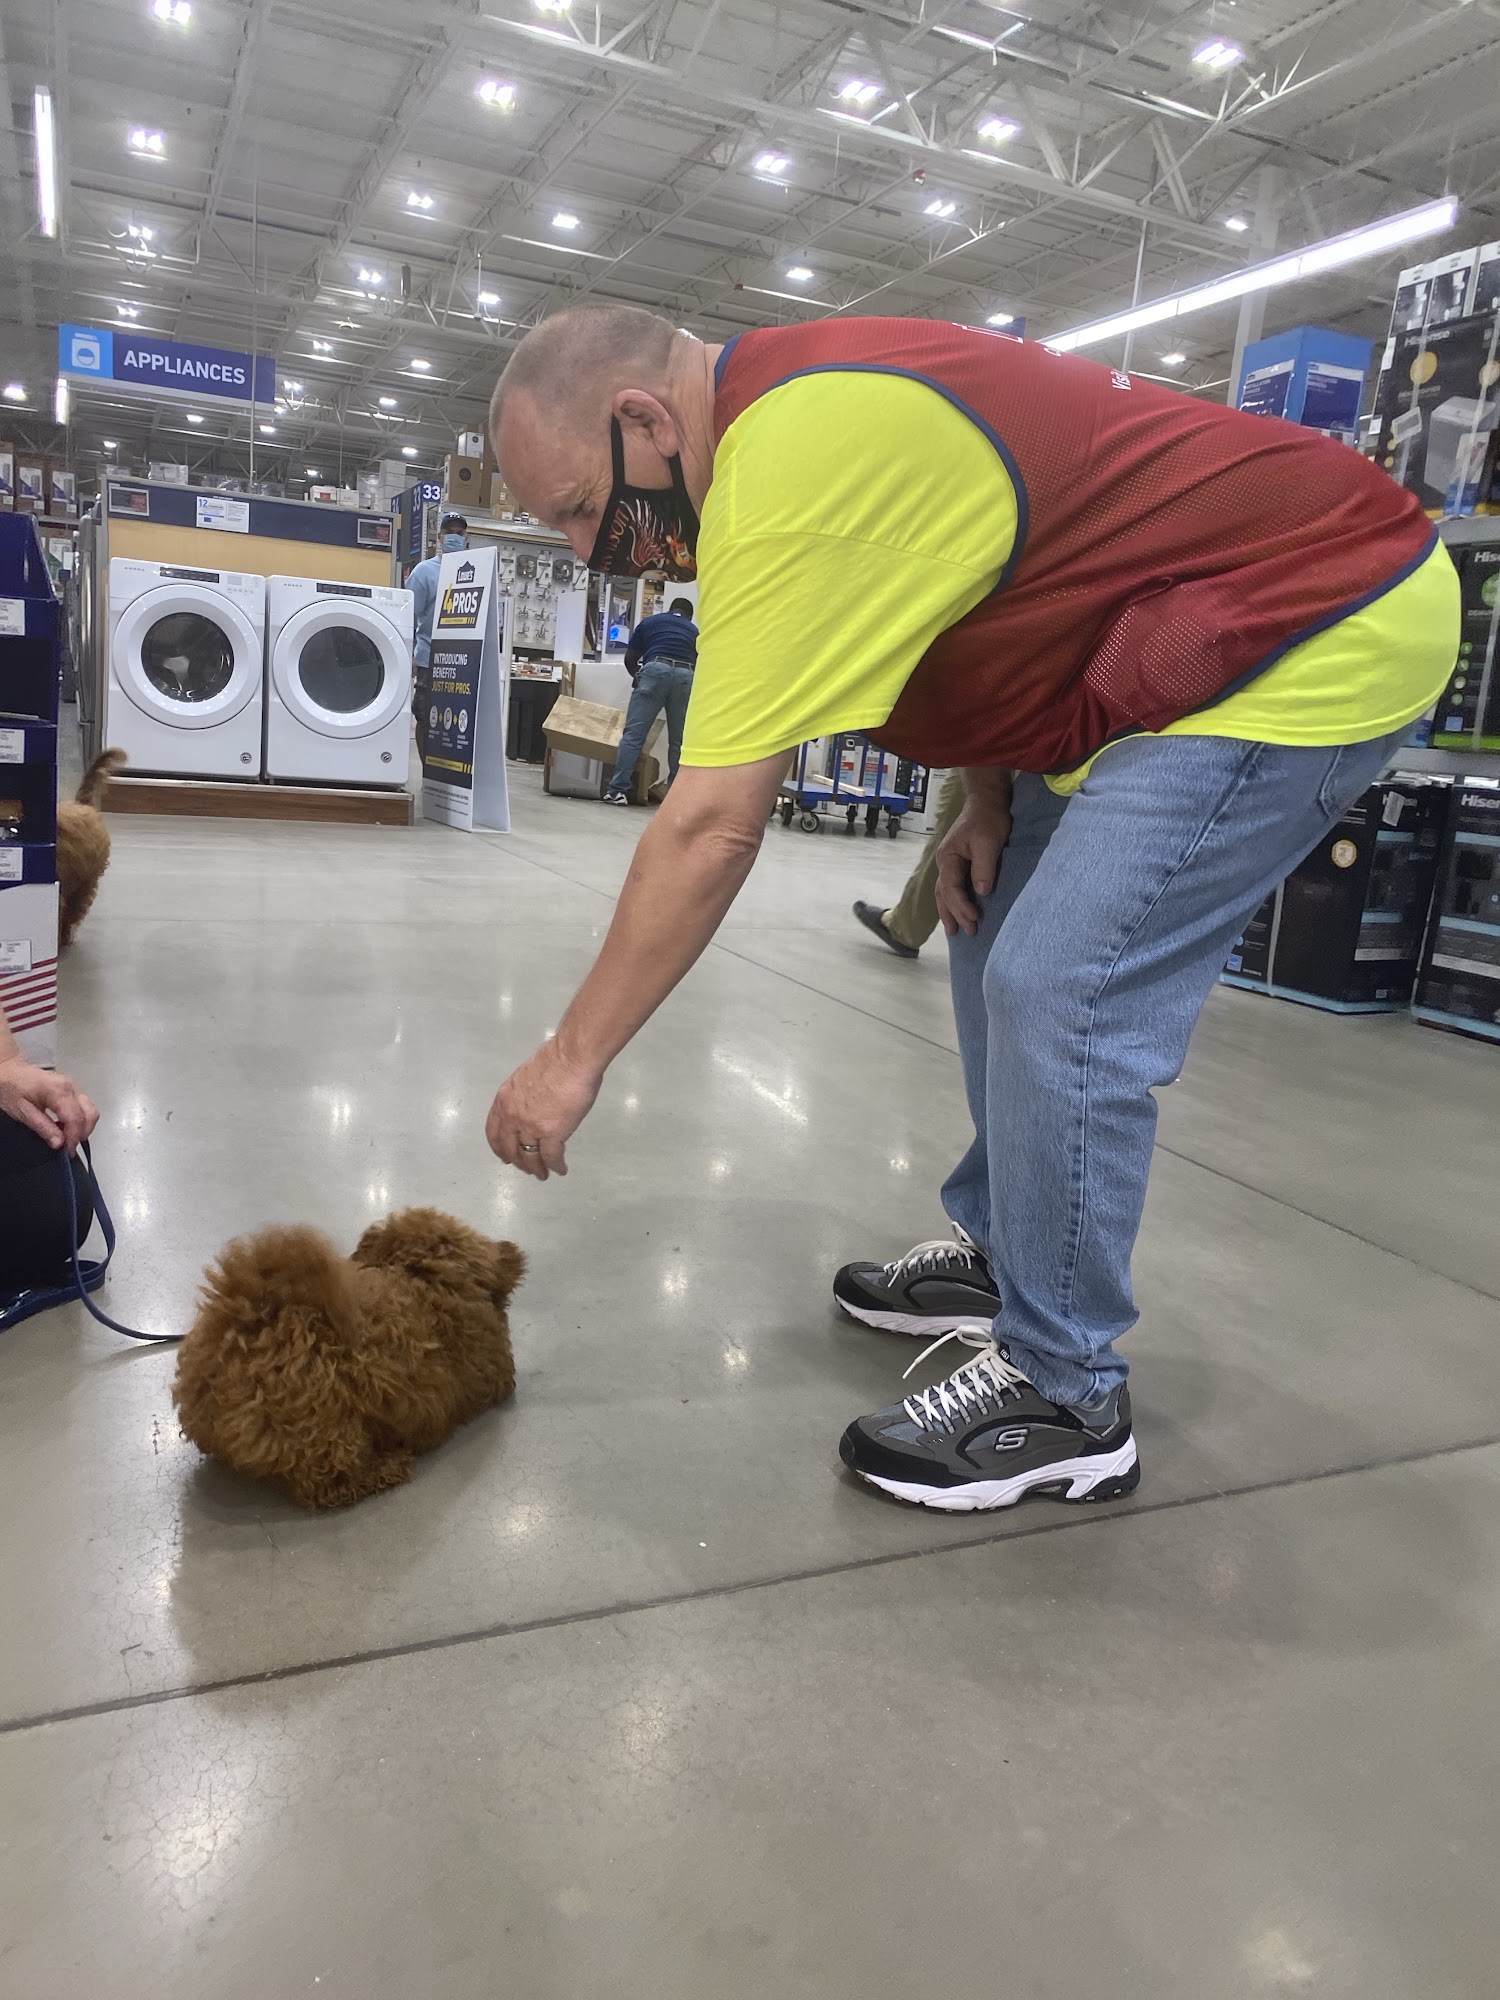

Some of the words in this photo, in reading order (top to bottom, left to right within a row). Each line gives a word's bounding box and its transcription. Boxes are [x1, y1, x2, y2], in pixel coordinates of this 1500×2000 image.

[123, 350, 246, 385] APPLIANCES
[422, 484, 440, 500] 33
[433, 653, 468, 665] INTRODUCING
[432, 667, 457, 679] BENEFITS
[431, 681, 445, 692] JUST
[444, 681, 455, 694] FOR
[455, 682, 472, 695] PROS.
[995, 1428, 1028, 1451] S
